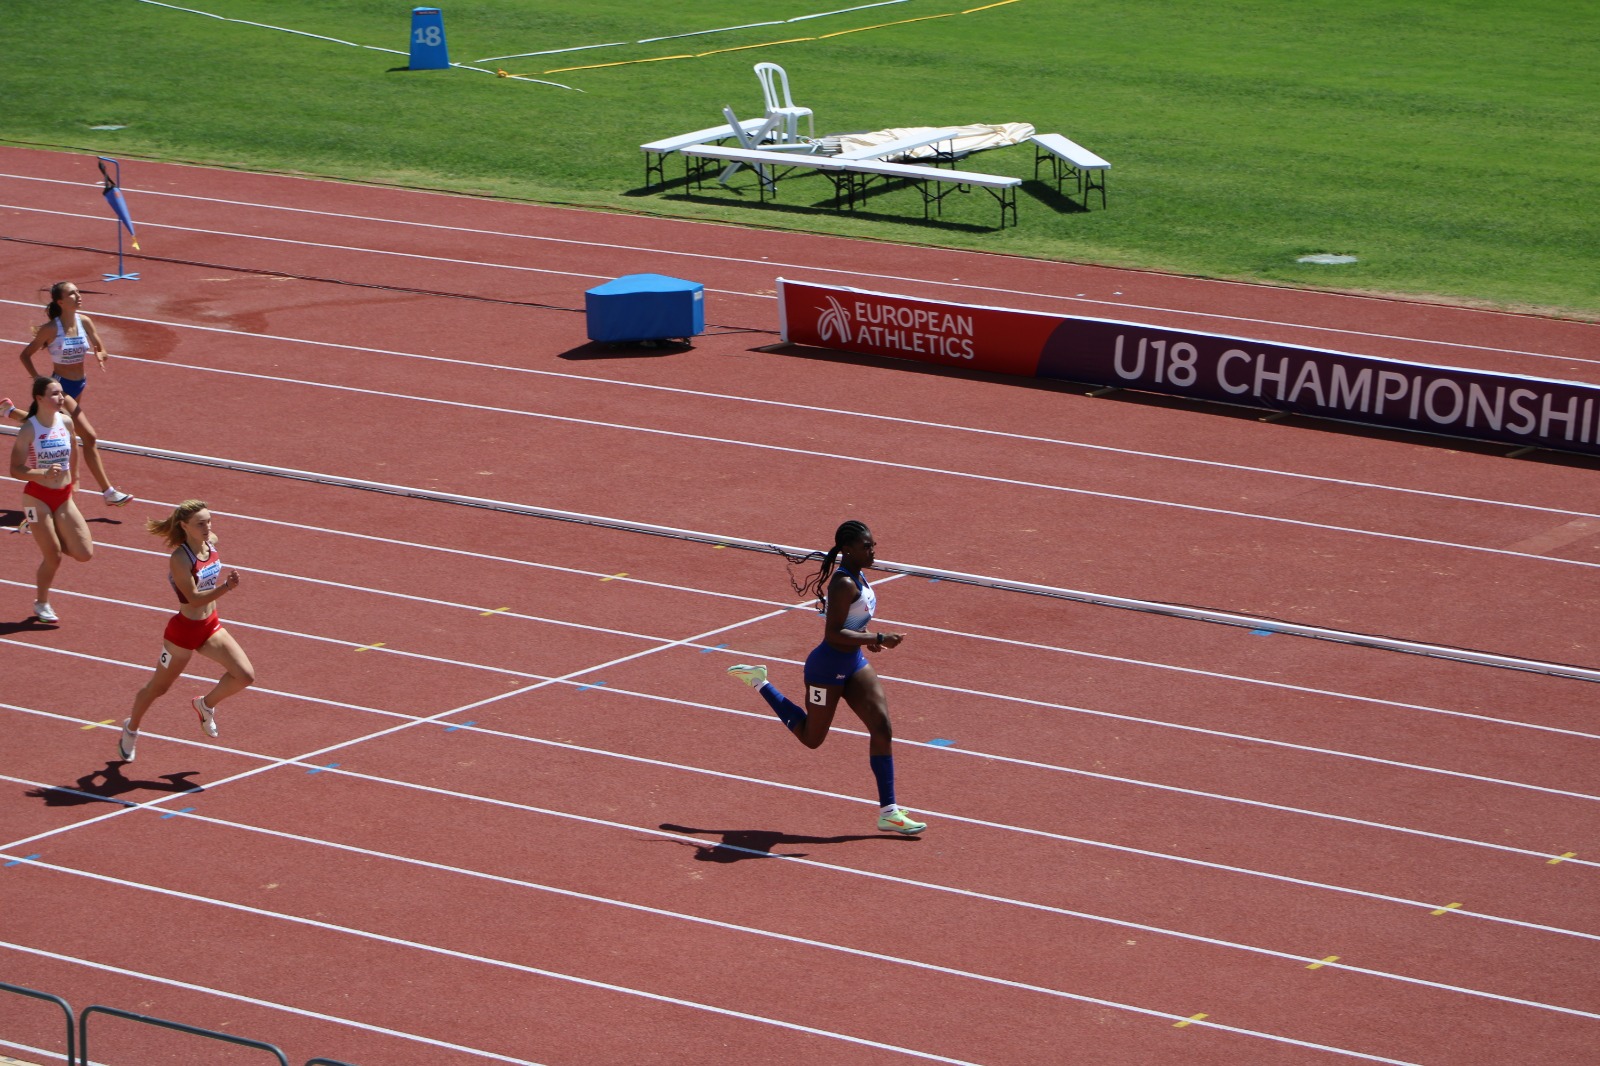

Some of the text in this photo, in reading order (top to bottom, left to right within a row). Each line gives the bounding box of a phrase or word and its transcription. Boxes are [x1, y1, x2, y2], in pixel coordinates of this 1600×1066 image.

[414, 26, 441, 46] 18
[855, 301, 974, 337] EUROPEAN
[857, 325, 975, 360] ATHLETICS
[1114, 334, 1198, 387] U18
[28, 509, 34, 521] 4
[161, 652, 168, 664] 6
[813, 689, 821, 702] 5
